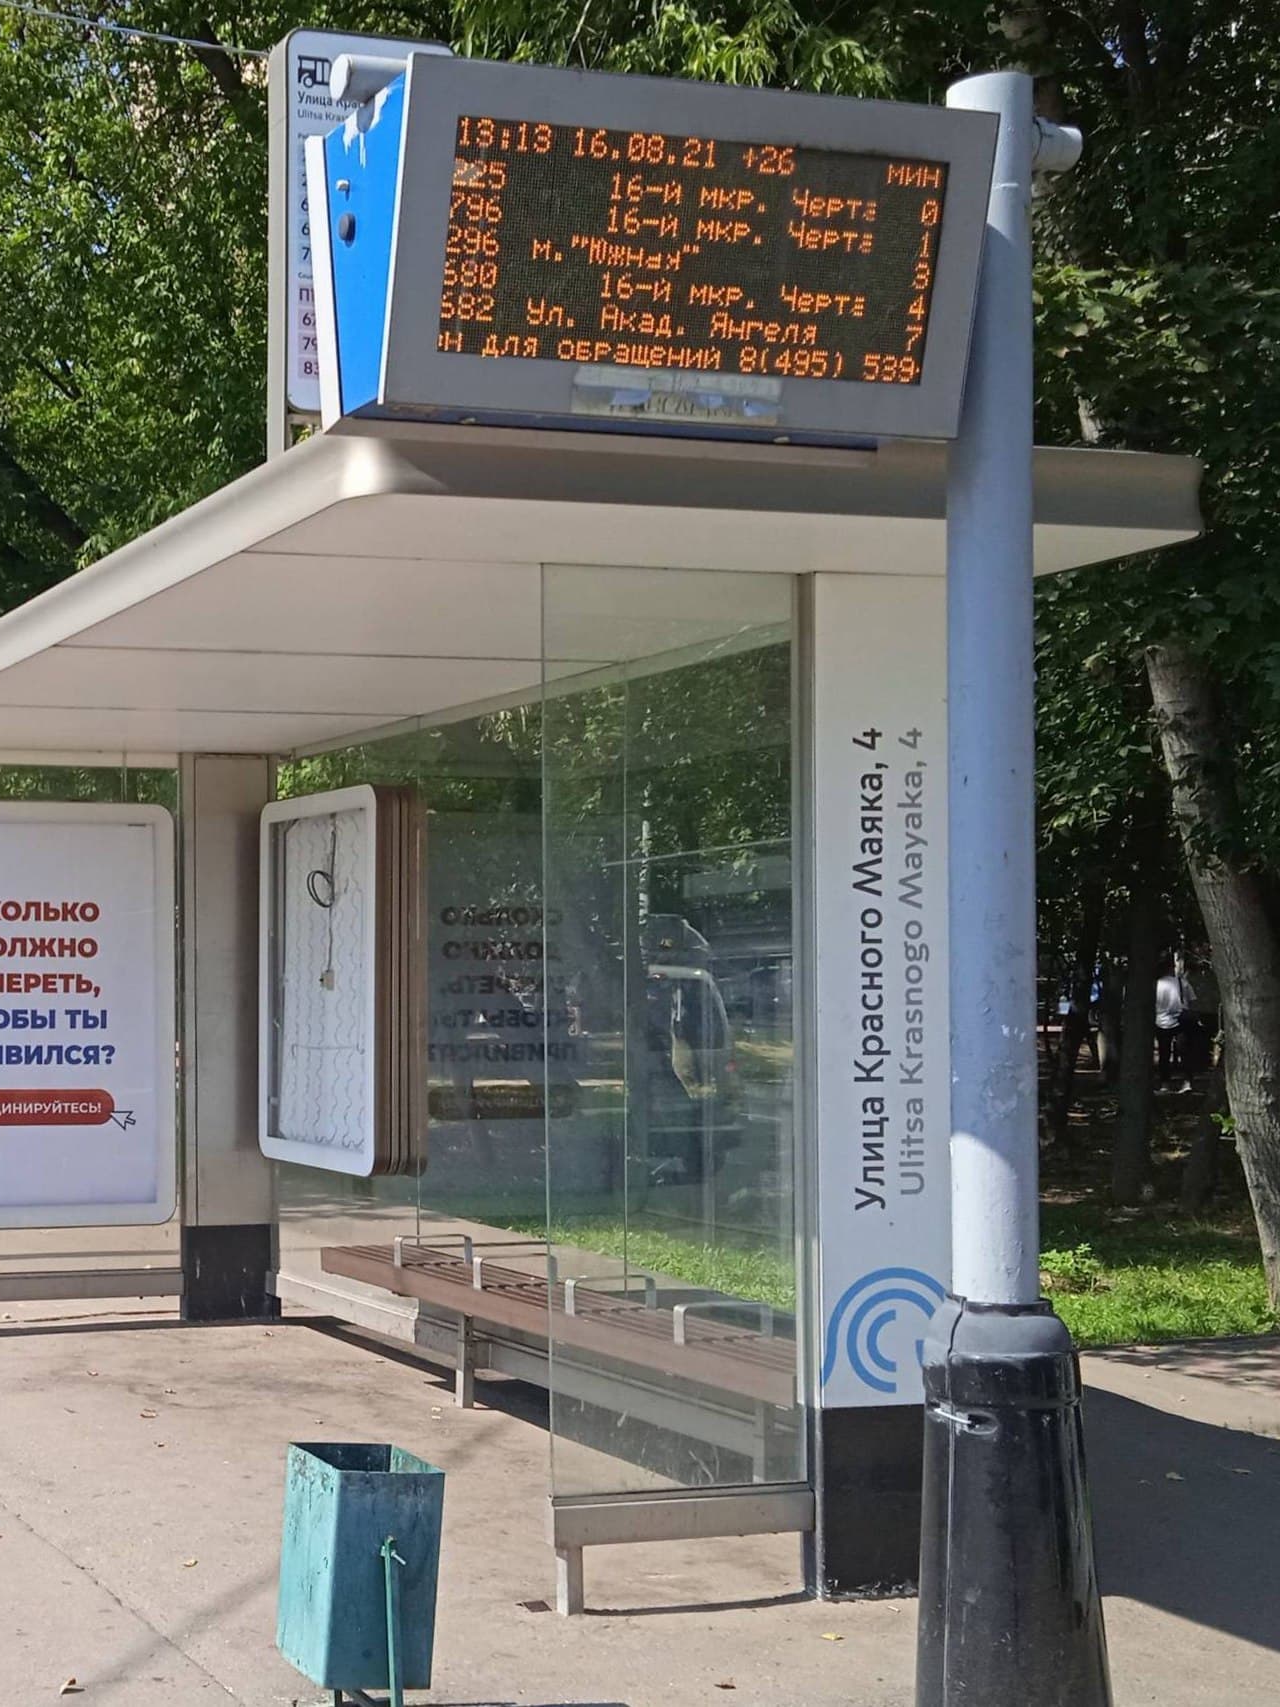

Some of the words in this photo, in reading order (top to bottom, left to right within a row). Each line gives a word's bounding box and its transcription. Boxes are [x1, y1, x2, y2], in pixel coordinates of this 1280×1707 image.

[458, 116, 552, 153] 13:13
[574, 127, 715, 169] 16.08.21
[742, 145, 796, 176] +26
[452, 157, 507, 190] 225
[611, 171, 682, 206] 16-й
[920, 200, 939, 226] 0
[446, 225, 500, 257] 296
[449, 191, 502, 223] 796
[607, 205, 678, 239] 16-й
[919, 230, 930, 258] 1
[600, 271, 672, 303] 16-й
[907, 294, 926, 321] 4
[600, 304, 685, 337] Акад.
[709, 311, 817, 346] Янгеля
[905, 324, 924, 352] 7
[557, 338, 721, 371] обращений
[739, 345, 844, 379] 8(495)
[863, 352, 921, 384] 539
[852, 728, 884, 751] 4
[897, 727, 923, 750] 4
[852, 762, 890, 897] Маяка,
[896, 760, 929, 910] Mayaka,
[64, 1009, 108, 1030] ТЫ
[852, 907, 892, 1083] Красного
[898, 919, 930, 1085] Krasnogo
[854, 1096, 890, 1212] Улица
[898, 1097, 926, 1196] Ulitsa
